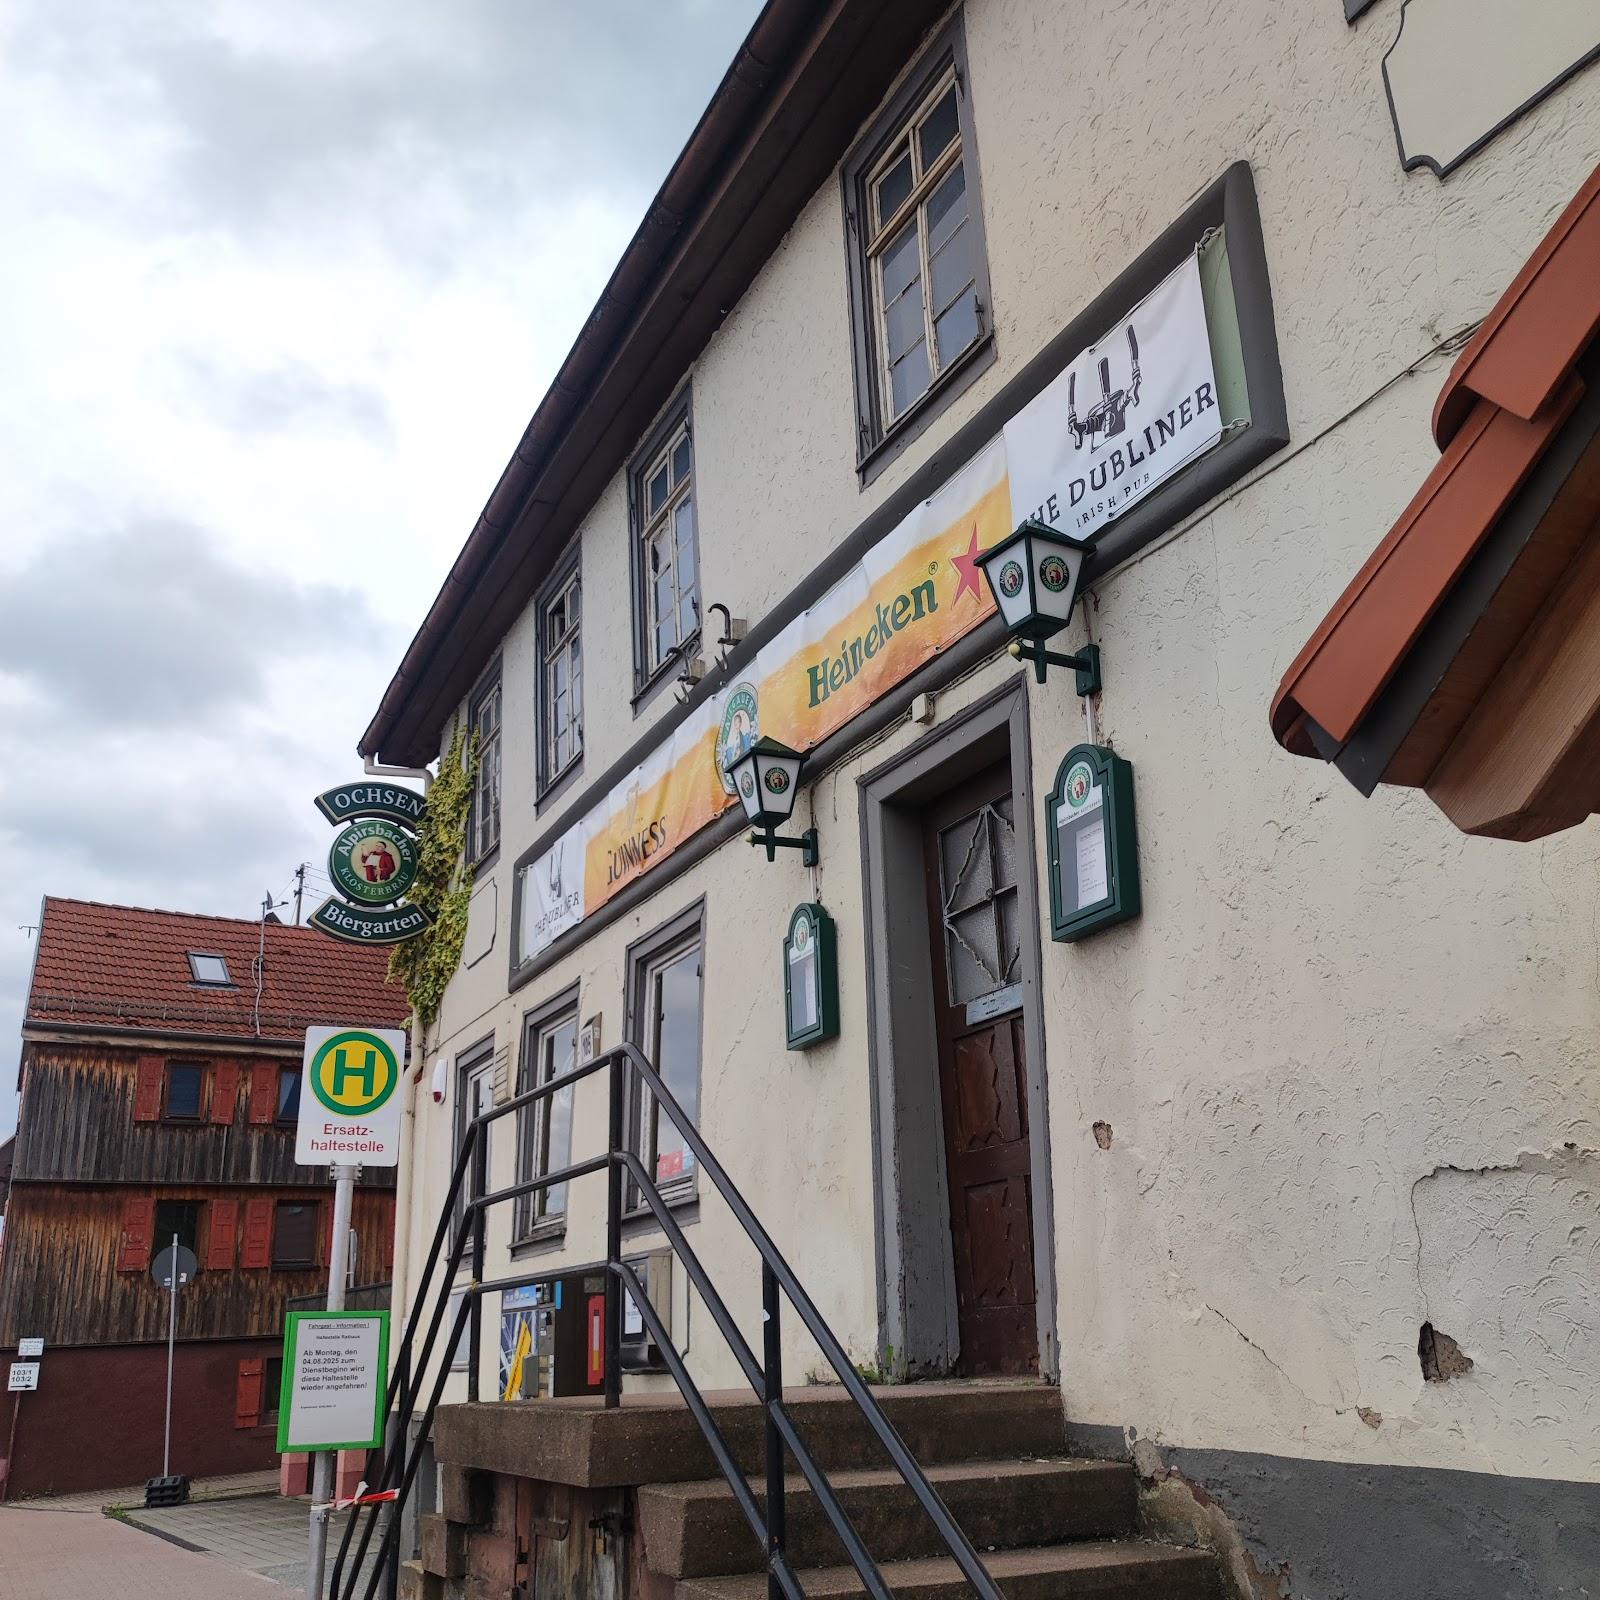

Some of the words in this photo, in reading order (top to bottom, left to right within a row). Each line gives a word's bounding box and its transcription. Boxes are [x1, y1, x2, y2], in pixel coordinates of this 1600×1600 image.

[1069, 382, 1215, 507] DUBLINER
[1076, 496, 1116, 528] IRISH
[1124, 472, 1150, 497] PUB
[806, 579, 939, 709] Heineken
[334, 787, 425, 816] OCHSEN
[337, 824, 412, 863] Alpirsbacher
[323, 904, 423, 937] Biergarten
[332, 1049, 376, 1096] H
[324, 1123, 373, 1136] Ersatz-
[310, 1139, 384, 1152] haltestelle
[315, 1349, 342, 1357] Montag,
[302, 1366, 347, 1374] Dienstbeginn
[325, 1382, 367, 1391] angefahren!
